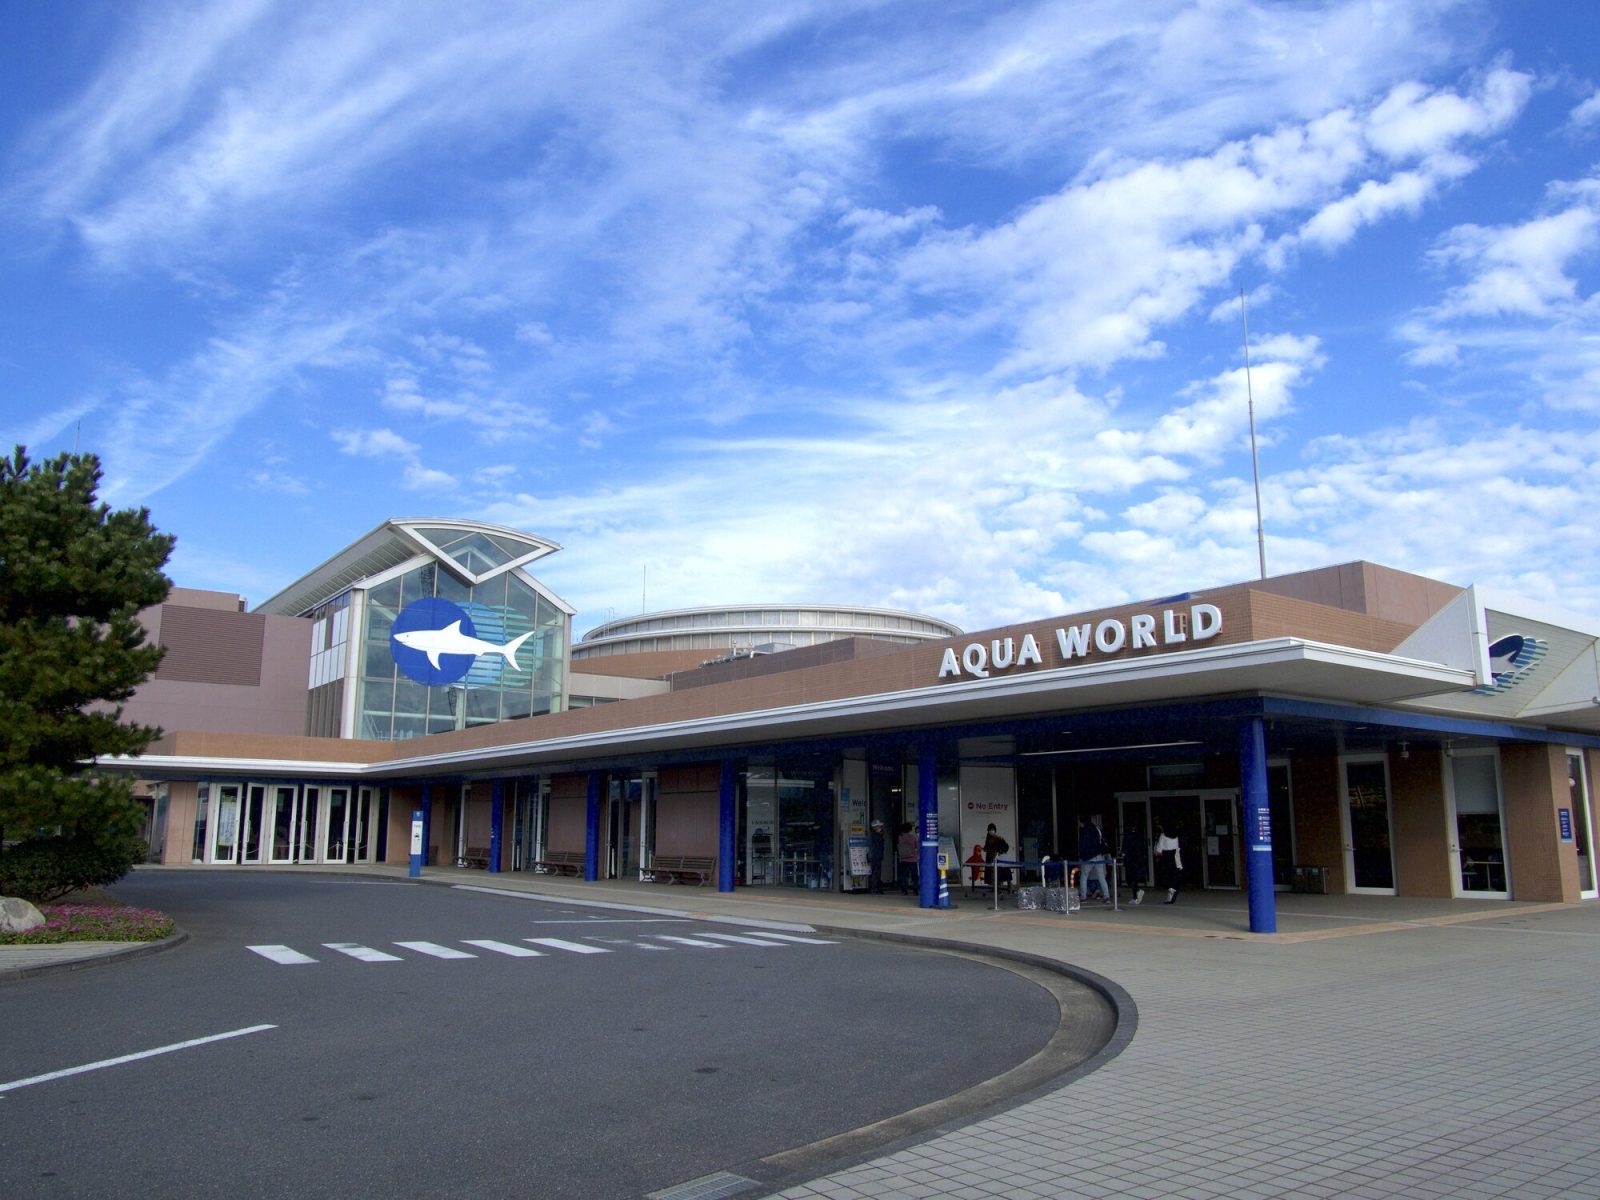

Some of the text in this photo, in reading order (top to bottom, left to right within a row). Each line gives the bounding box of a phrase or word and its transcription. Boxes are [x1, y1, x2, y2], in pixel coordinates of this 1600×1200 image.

[939, 604, 1222, 678] AQUA WORLD
[976, 802, 1008, 811] No Entry
